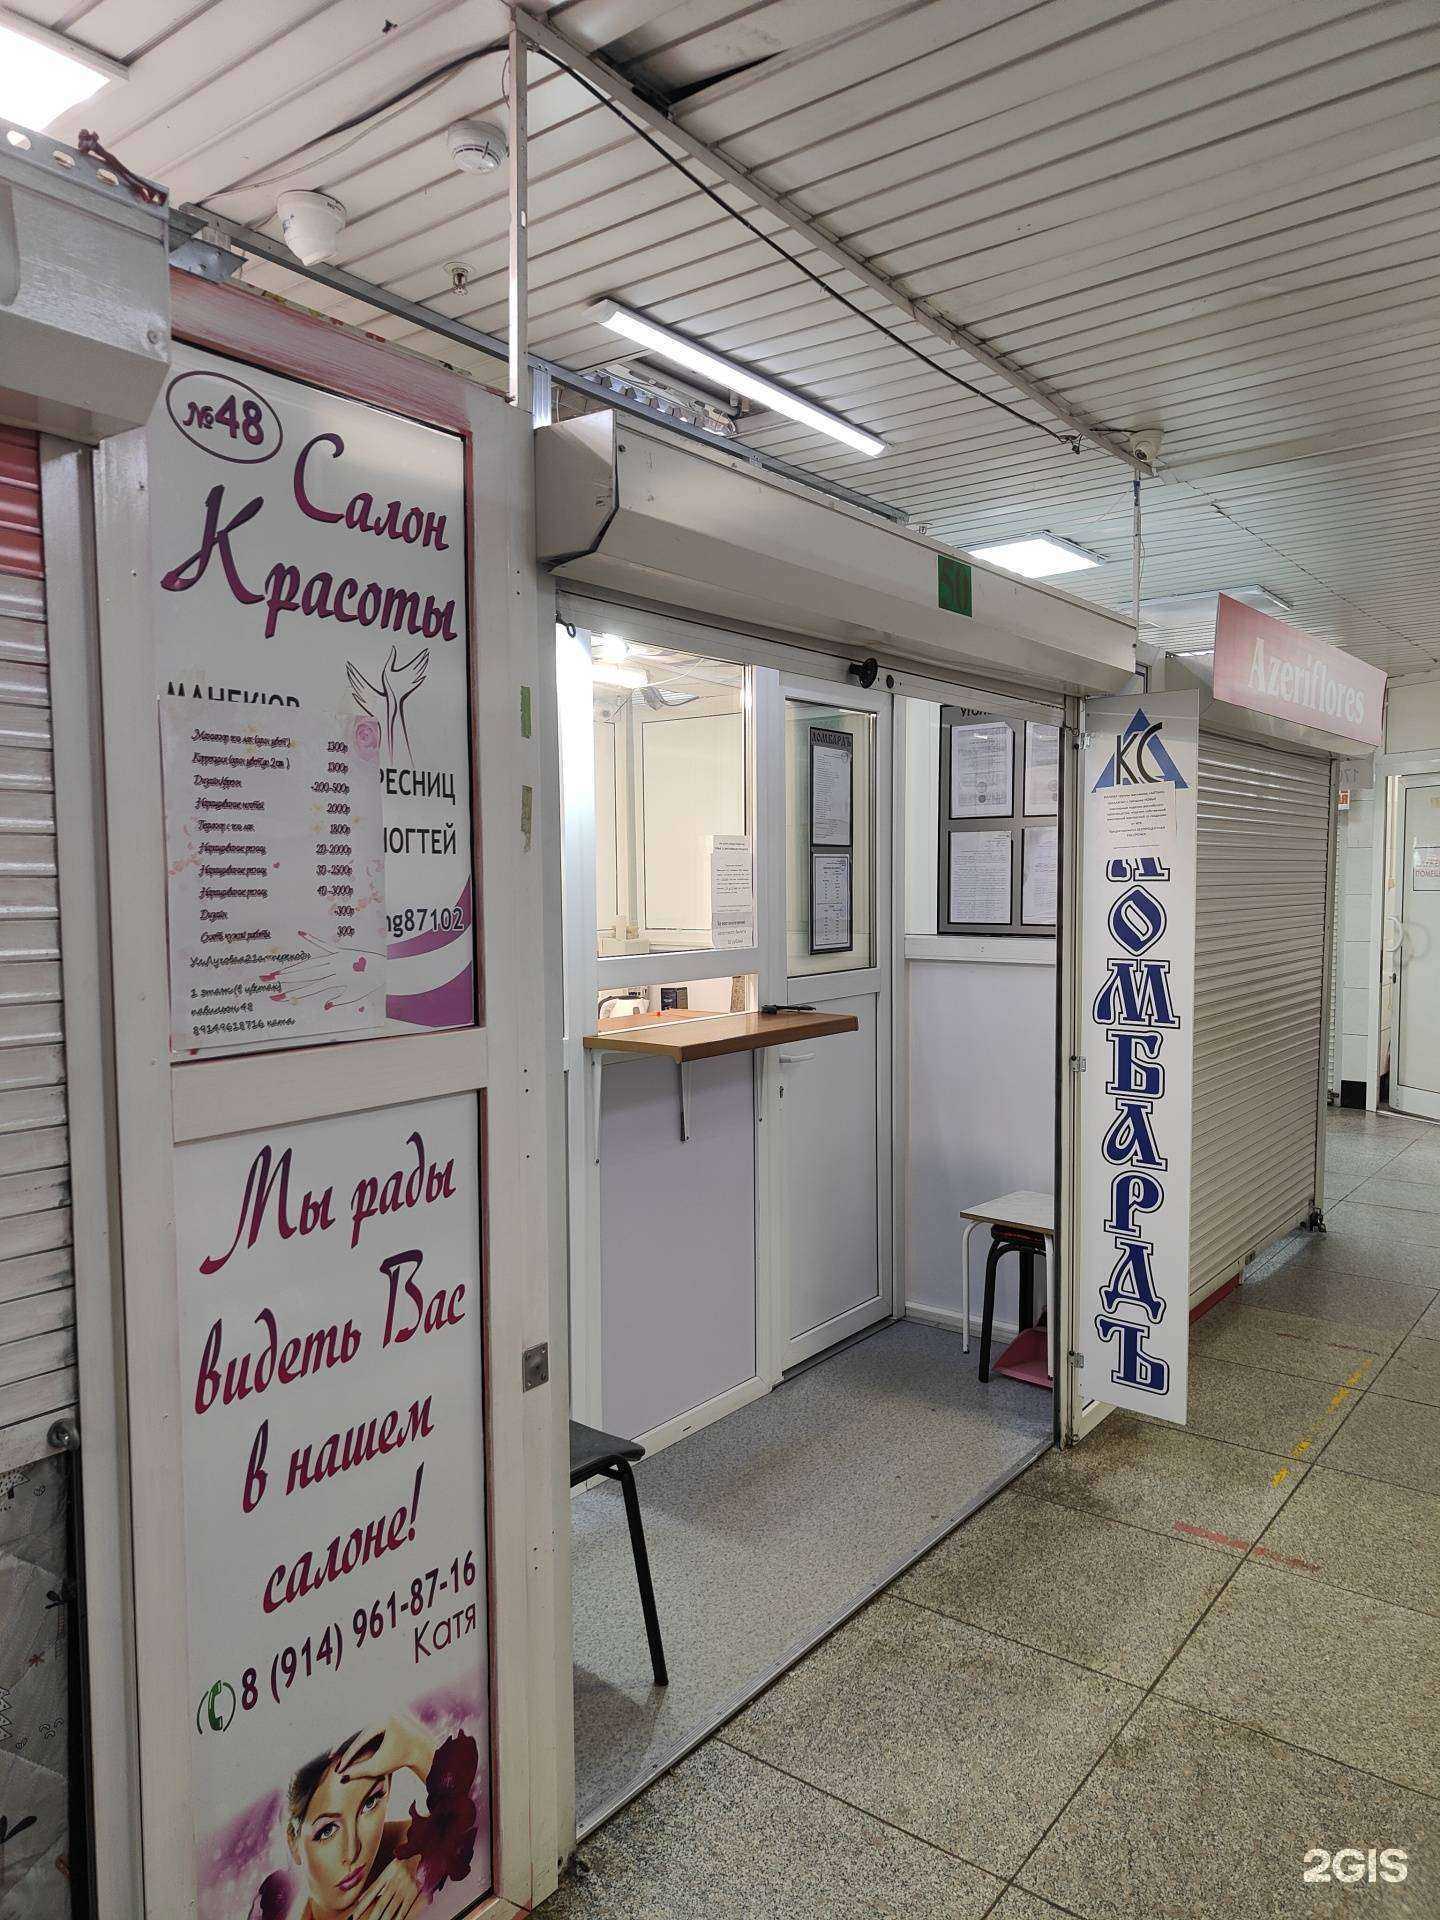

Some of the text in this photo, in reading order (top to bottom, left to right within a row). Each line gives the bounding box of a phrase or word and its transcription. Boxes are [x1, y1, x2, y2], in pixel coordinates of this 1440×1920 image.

[183, 395, 264, 446] №48
[294, 432, 449, 550] Салон
[160, 484, 458, 641] Красоты
[1248, 637, 1365, 725] Azeriflores
[380, 768, 456, 806] ЕСНИЦ
[384, 822, 457, 855] ОГТЕЙ
[199, 1131, 456, 1275] Мы рады
[194, 1249, 465, 1415] видеть Вас
[242, 1395, 435, 1513] в нашем
[262, 1461, 425, 1614] салоне!
[241, 1549, 476, 1711] 8 (914) 961-87-16
[414, 1603, 476, 1664] Катя
